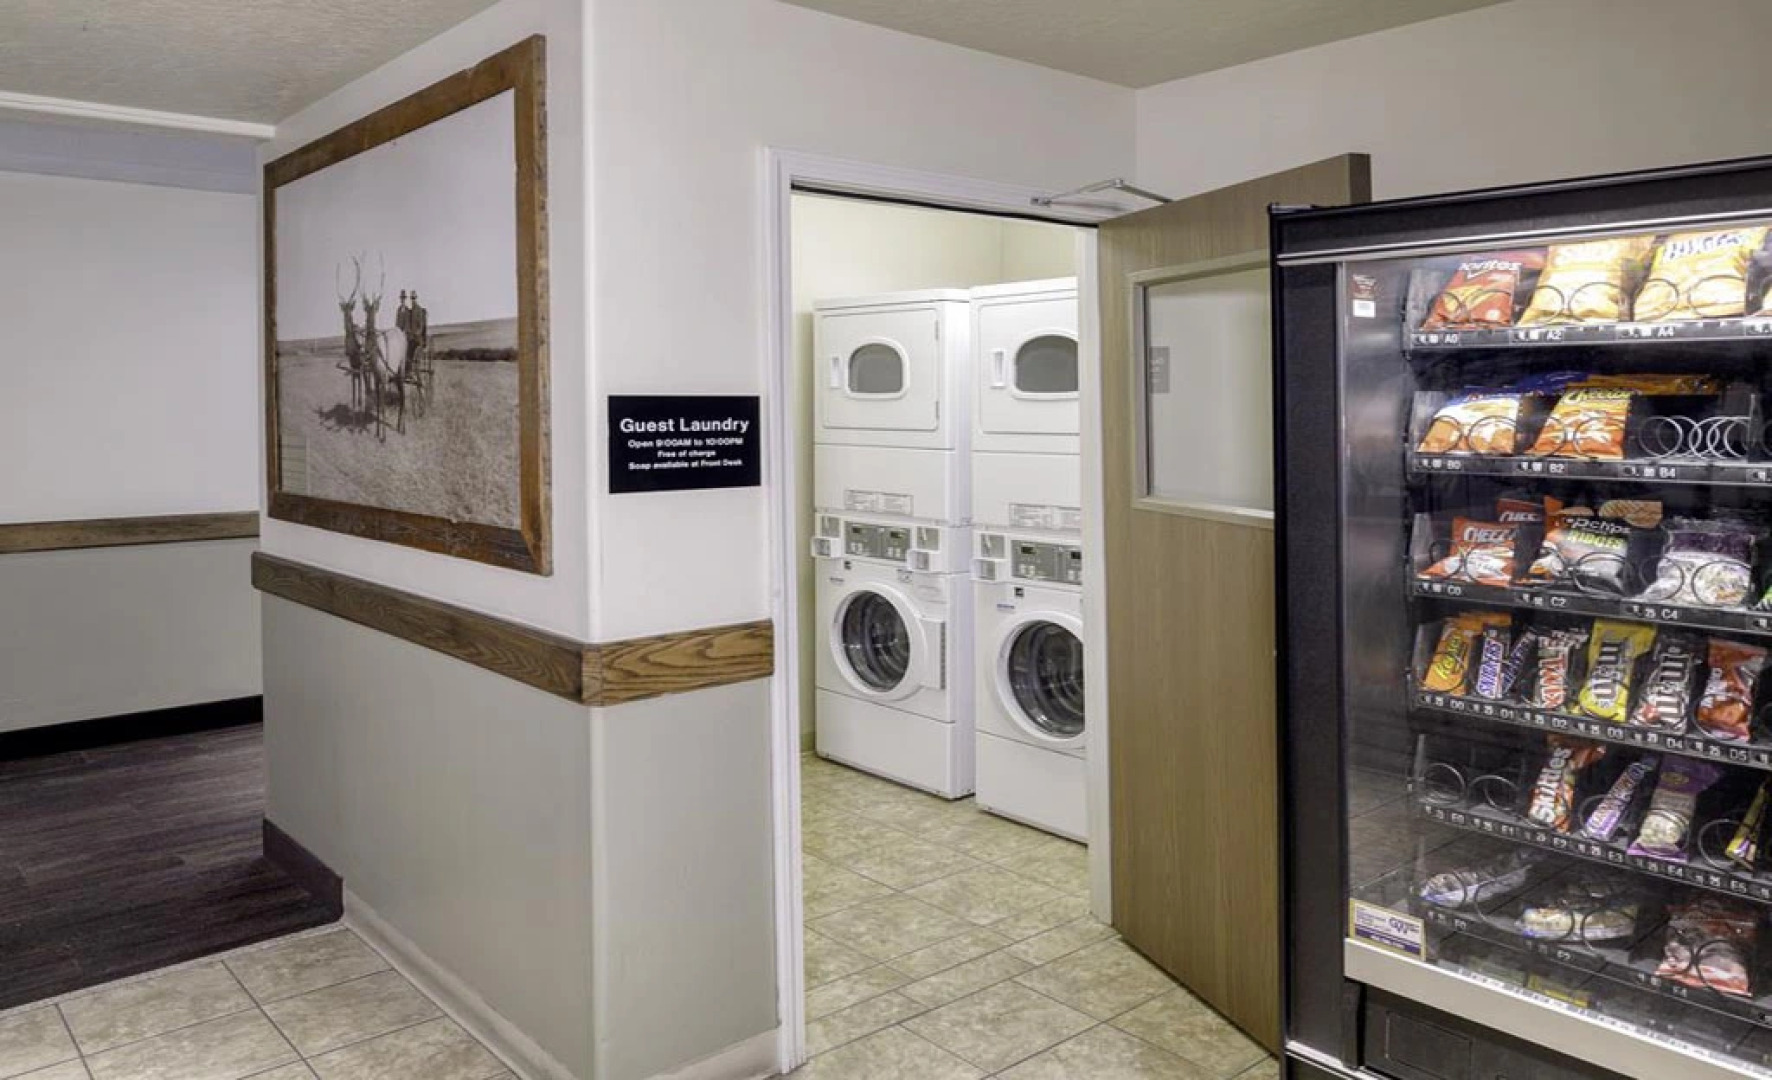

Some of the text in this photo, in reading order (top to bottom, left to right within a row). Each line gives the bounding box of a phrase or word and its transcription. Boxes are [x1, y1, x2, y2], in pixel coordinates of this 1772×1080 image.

[620, 417, 749, 433] Guest Laundry
[627, 439, 654, 449] Open
[694, 438, 704, 447] to
[657, 449, 716, 458] Free of charge
[628, 457, 743, 471] Soap available at Front Desk
[1550, 596, 1567, 607] C2
[1661, 608, 1678, 619] C4
[1665, 737, 1683, 749] D4
[1729, 748, 1748, 761] D5
